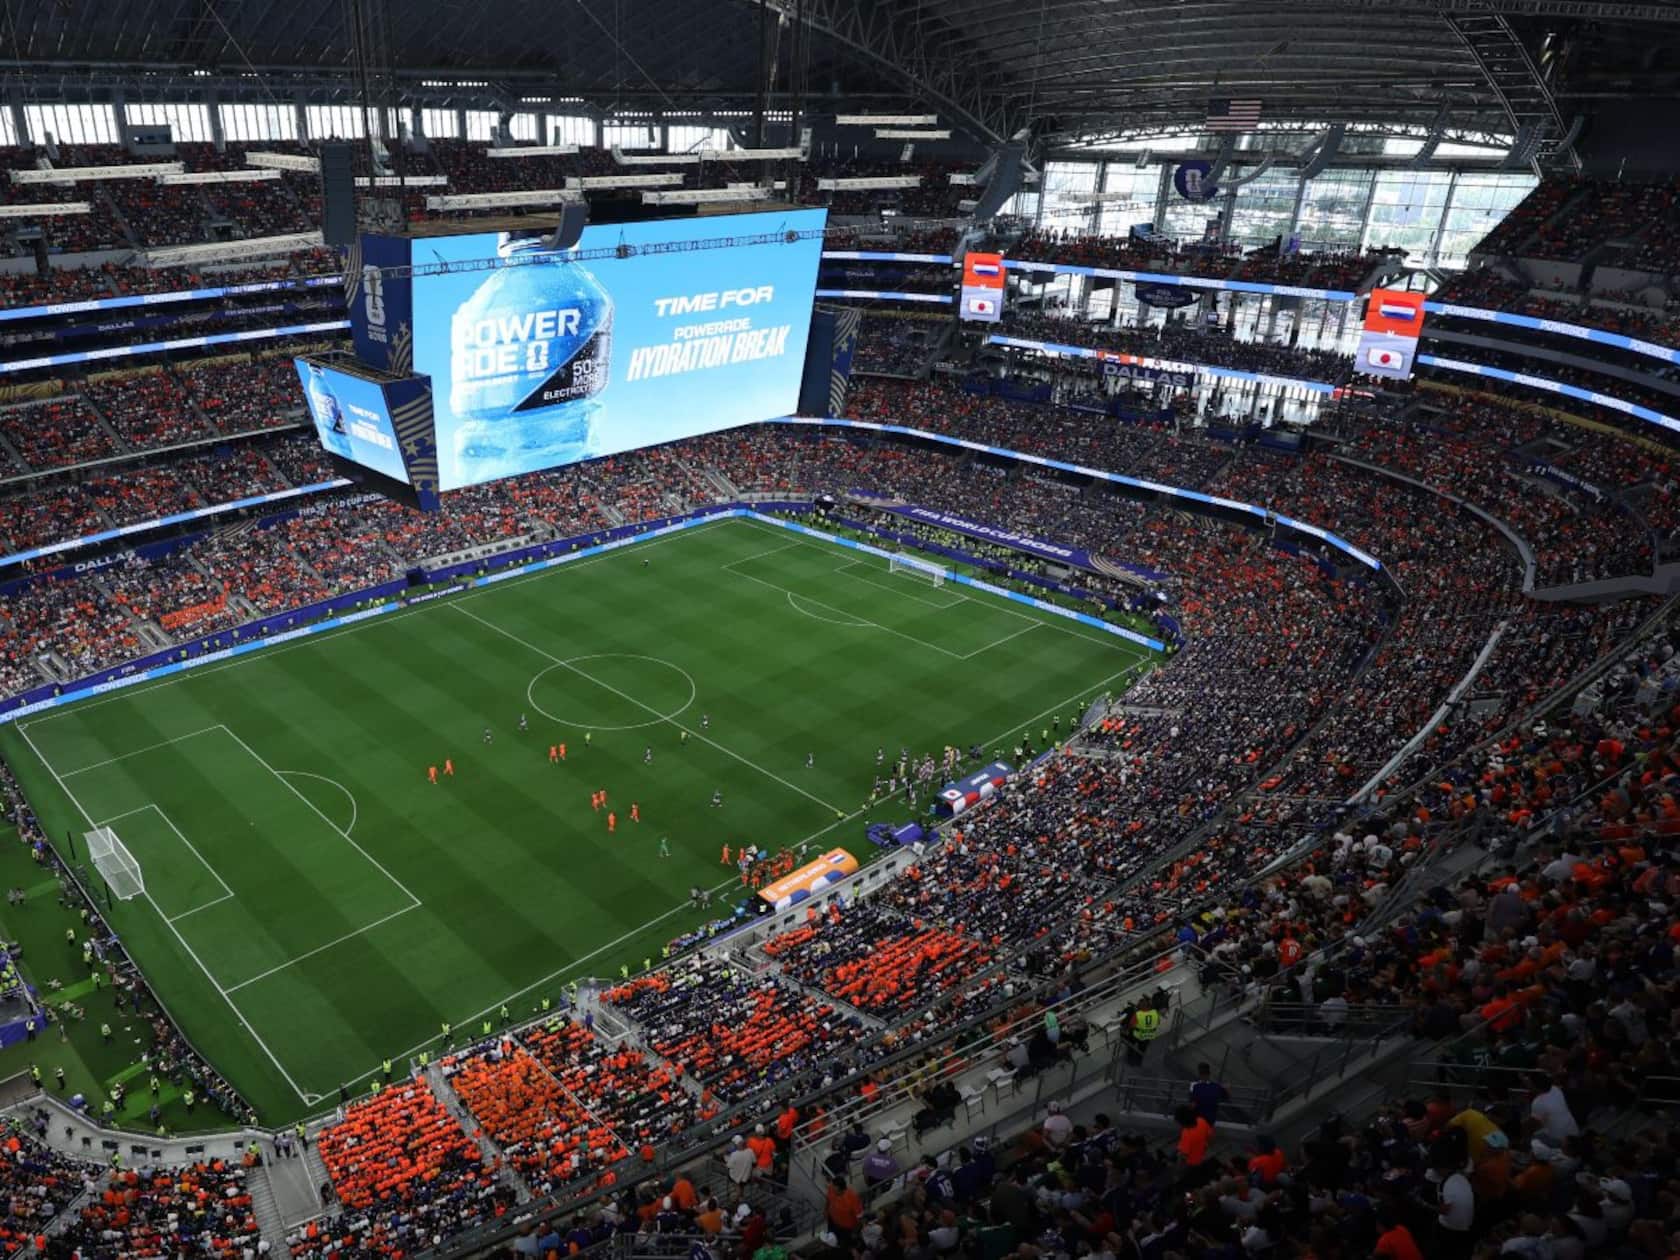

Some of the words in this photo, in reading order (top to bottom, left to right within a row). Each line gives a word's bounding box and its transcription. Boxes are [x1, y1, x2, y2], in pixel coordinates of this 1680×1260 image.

[655, 293, 718, 317] TIME
[720, 285, 774, 309] FOR
[455, 308, 582, 348] POWER
[626, 336, 732, 382] HYDRATION
[731, 325, 791, 362] BREAK
[1103, 363, 1187, 386] DALLAS
[911, 508, 940, 521] FIFA
[941, 515, 989, 534] WORLD
[989, 529, 1021, 541] CUP
[1019, 538, 1073, 557] 2026
[75, 551, 136, 573] DALLAS
